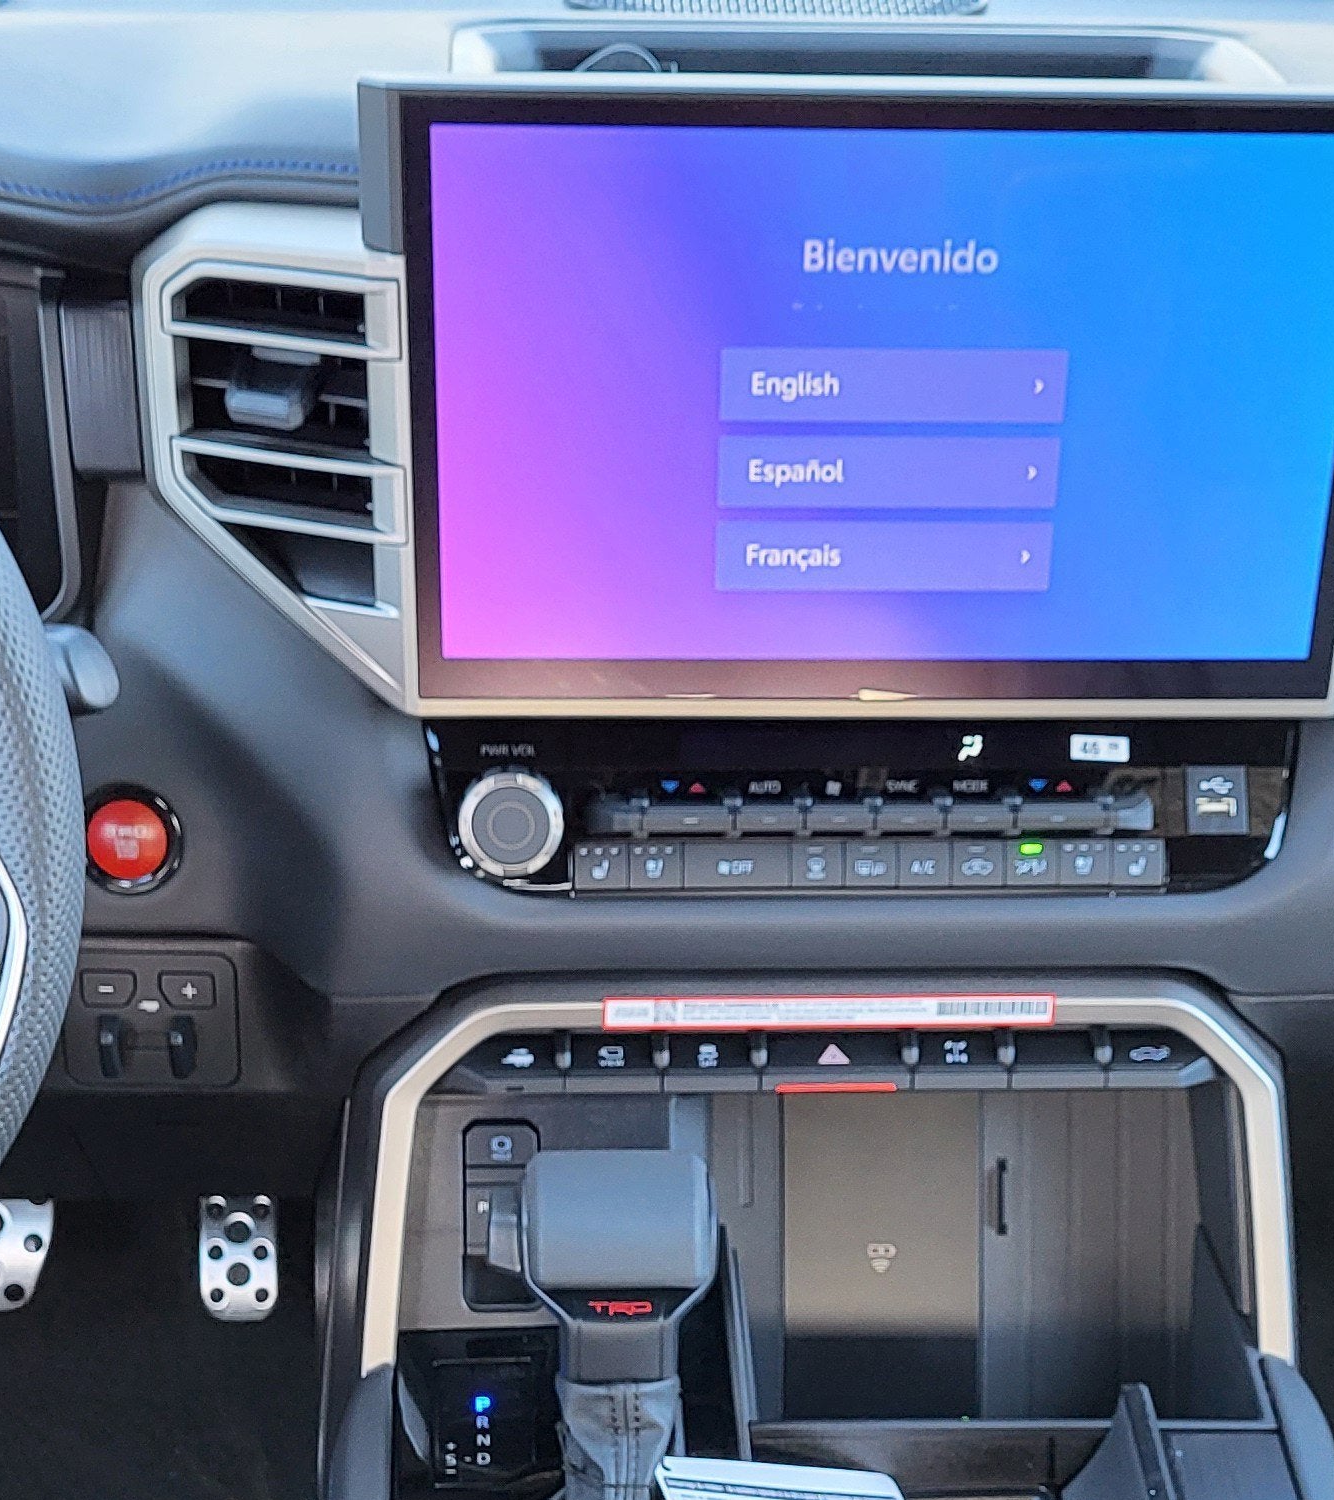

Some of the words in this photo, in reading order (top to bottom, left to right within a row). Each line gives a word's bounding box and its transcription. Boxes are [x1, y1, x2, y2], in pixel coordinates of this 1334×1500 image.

[802, 238, 999, 274] Bienvenido
[750, 370, 841, 402] English
[748, 458, 845, 488] Español
[745, 543, 842, 572] Français
[588, 1300, 653, 1317] TRD
[475, 1396, 491, 1413] P
[476, 1415, 490, 1430] R
[476, 1433, 491, 1447] N
[476, 1452, 491, 1466] D
